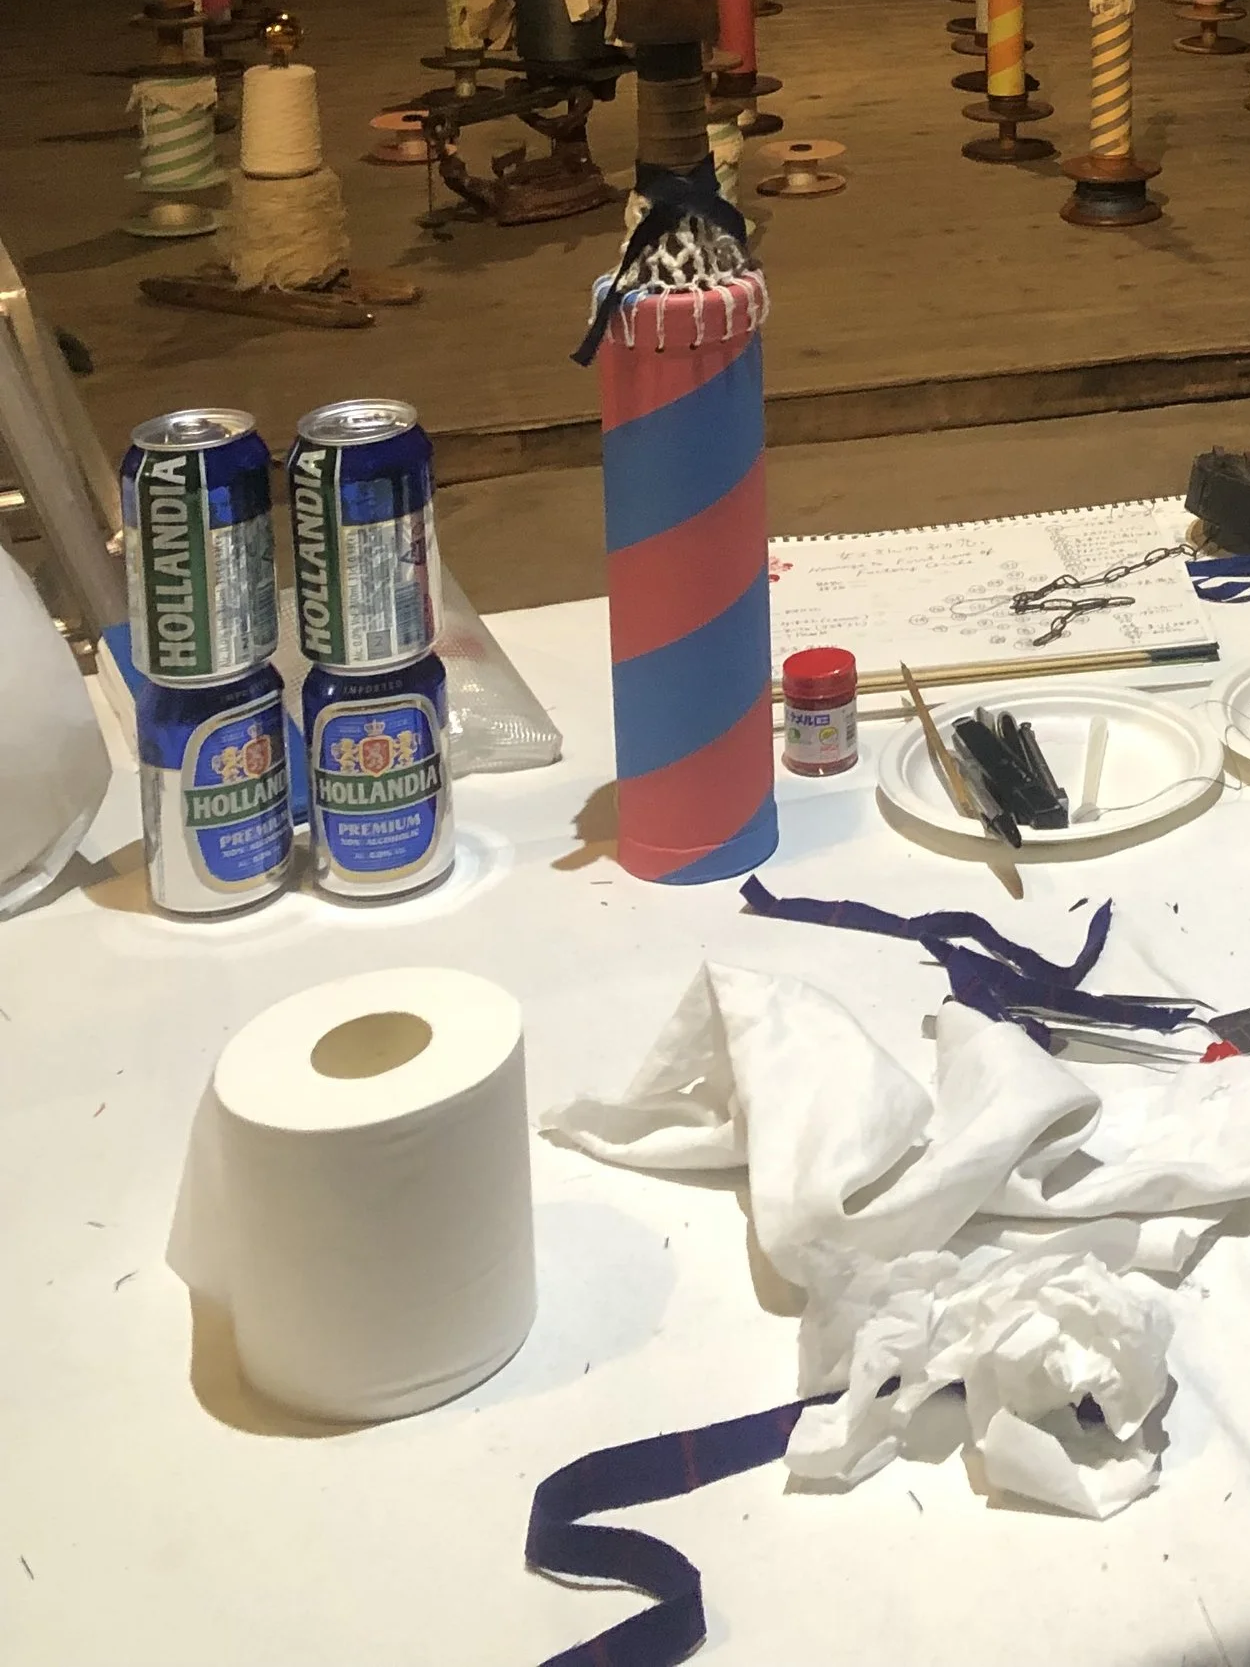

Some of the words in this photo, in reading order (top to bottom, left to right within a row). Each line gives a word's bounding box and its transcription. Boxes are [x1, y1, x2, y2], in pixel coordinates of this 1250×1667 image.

[149, 454, 197, 668] HOLLANDIA
[294, 448, 332, 656] HOLLANDIA
[319, 764, 438, 805] HOLLANDIA
[338, 813, 421, 837] PREMIUM
